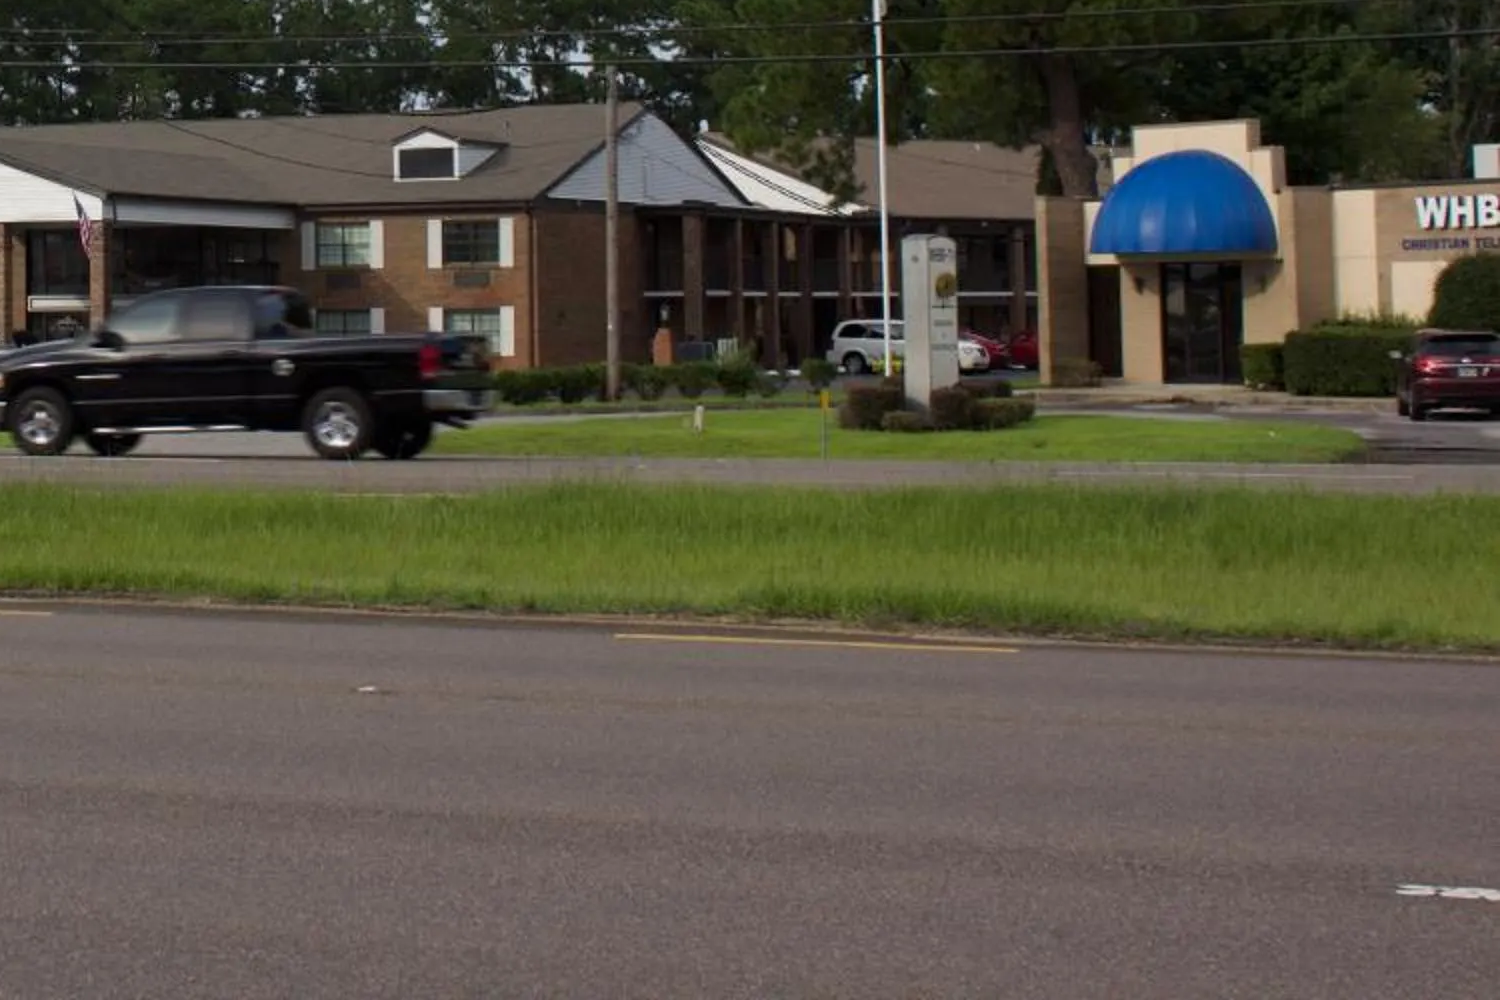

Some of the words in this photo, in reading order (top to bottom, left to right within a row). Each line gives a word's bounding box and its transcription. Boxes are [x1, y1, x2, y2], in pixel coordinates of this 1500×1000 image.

[1414, 194, 1500, 229] WHB
[1402, 238, 1469, 250] CHRISTIAN
[1476, 236, 1500, 248] TEL
